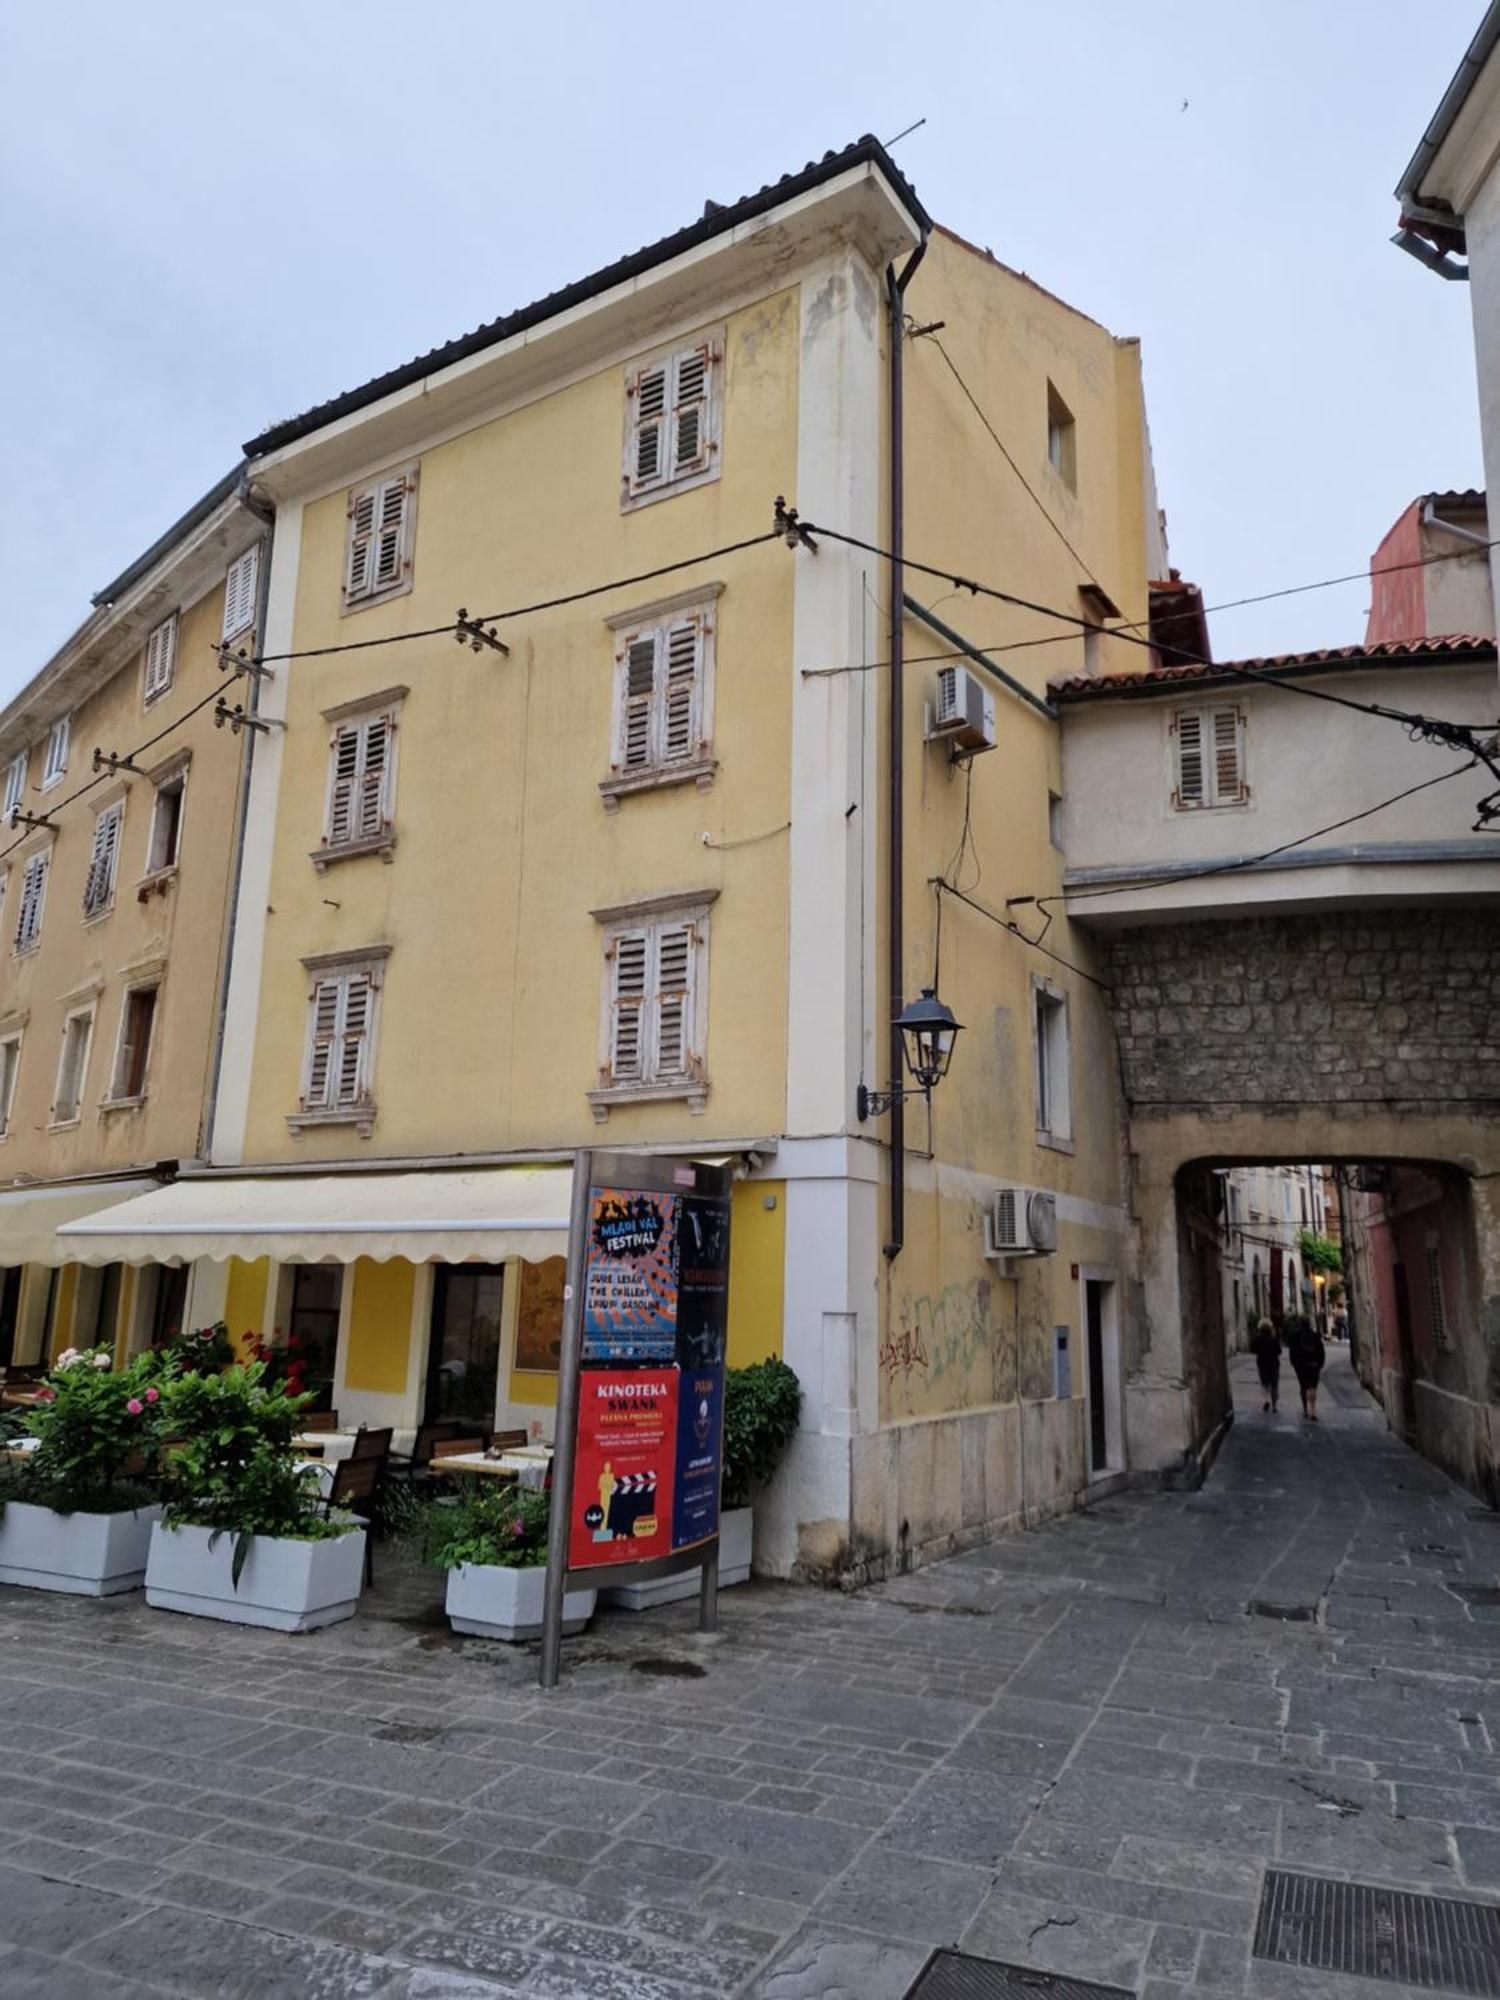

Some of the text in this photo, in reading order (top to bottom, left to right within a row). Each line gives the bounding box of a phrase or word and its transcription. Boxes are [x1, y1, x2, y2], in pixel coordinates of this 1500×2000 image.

[601, 1217, 658, 1237] MLADI VAL
[607, 1231, 656, 1251] FESTIVAL
[589, 1286, 606, 1297] THE
[597, 1383, 668, 1398] KINOTEKA
